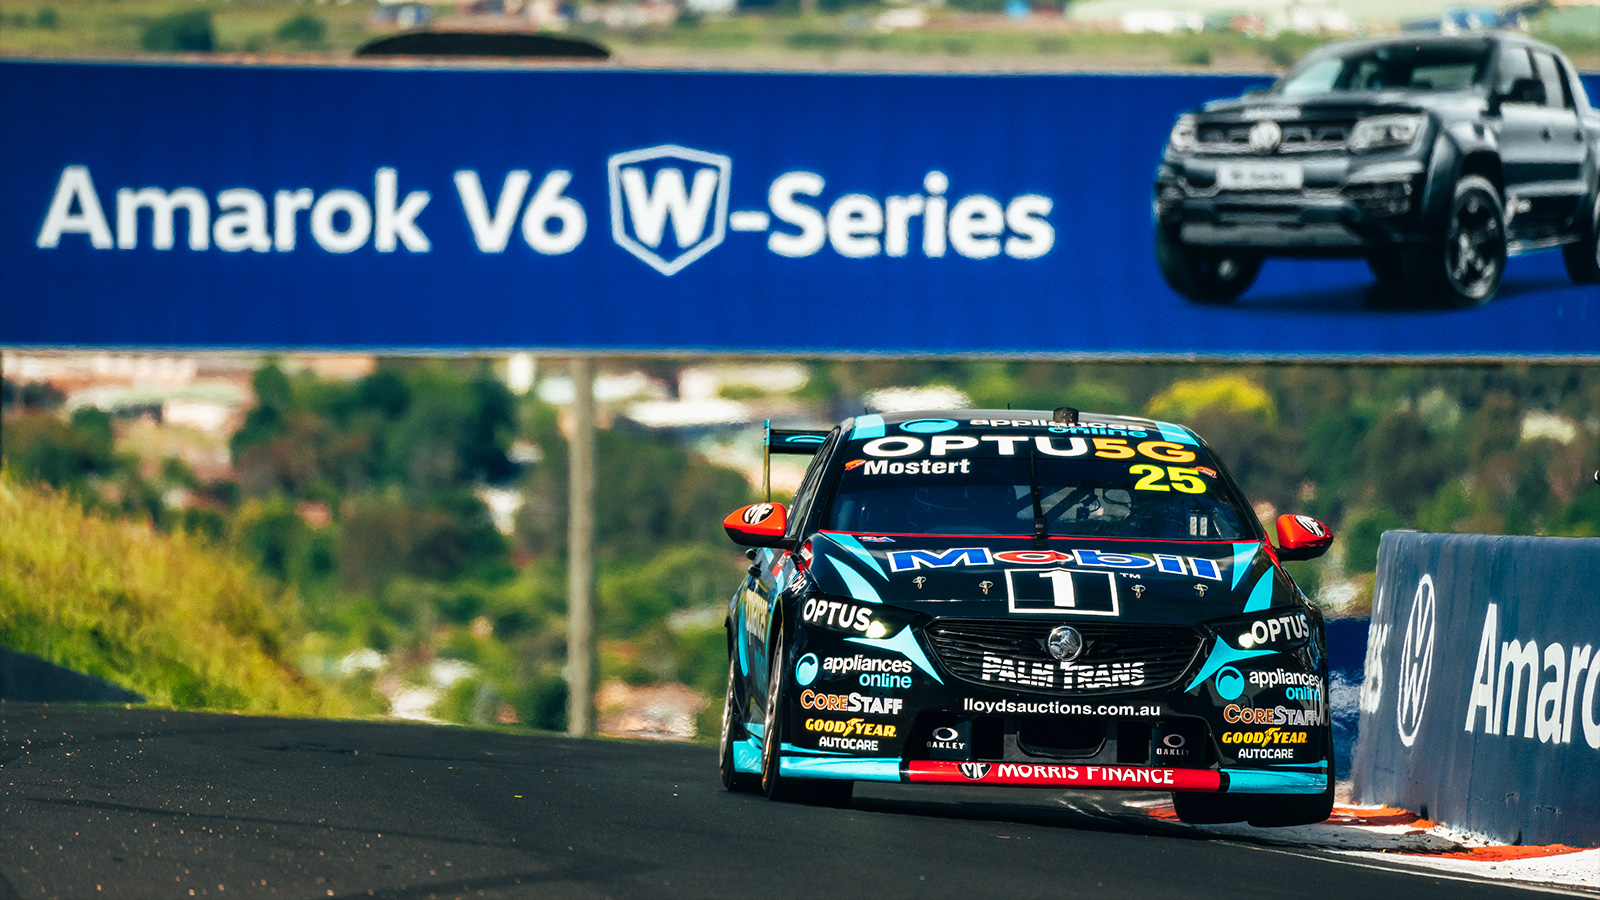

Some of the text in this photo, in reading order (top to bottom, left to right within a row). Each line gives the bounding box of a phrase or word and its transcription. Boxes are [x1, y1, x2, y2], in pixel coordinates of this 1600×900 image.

[36, 165, 432, 254] Amarok
[453, 169, 588, 256] V6
[863, 458, 971, 475] Mostert
[1129, 463, 1207, 494] 25
[887, 547, 1223, 581] Mobil
[803, 598, 873, 632] OPTUS
[1250, 614, 1310, 645] OPTUS
[822, 654, 913, 674] appliances
[982, 651, 1146, 690] PALM TRANS
[858, 673, 913, 690] online
[1249, 668, 1320, 689] appliances
[1285, 686, 1321, 702] online
[963, 696, 1161, 718] lloydsauctions.com.au
[818, 736, 879, 751] AUTOCARE
[926, 741, 966, 750] OAKLEY
[1156, 747, 1189, 756] OAKLEY
[1238, 748, 1294, 759] AUTOCARE
[997, 763, 1175, 784] MORRIS FINANCE
